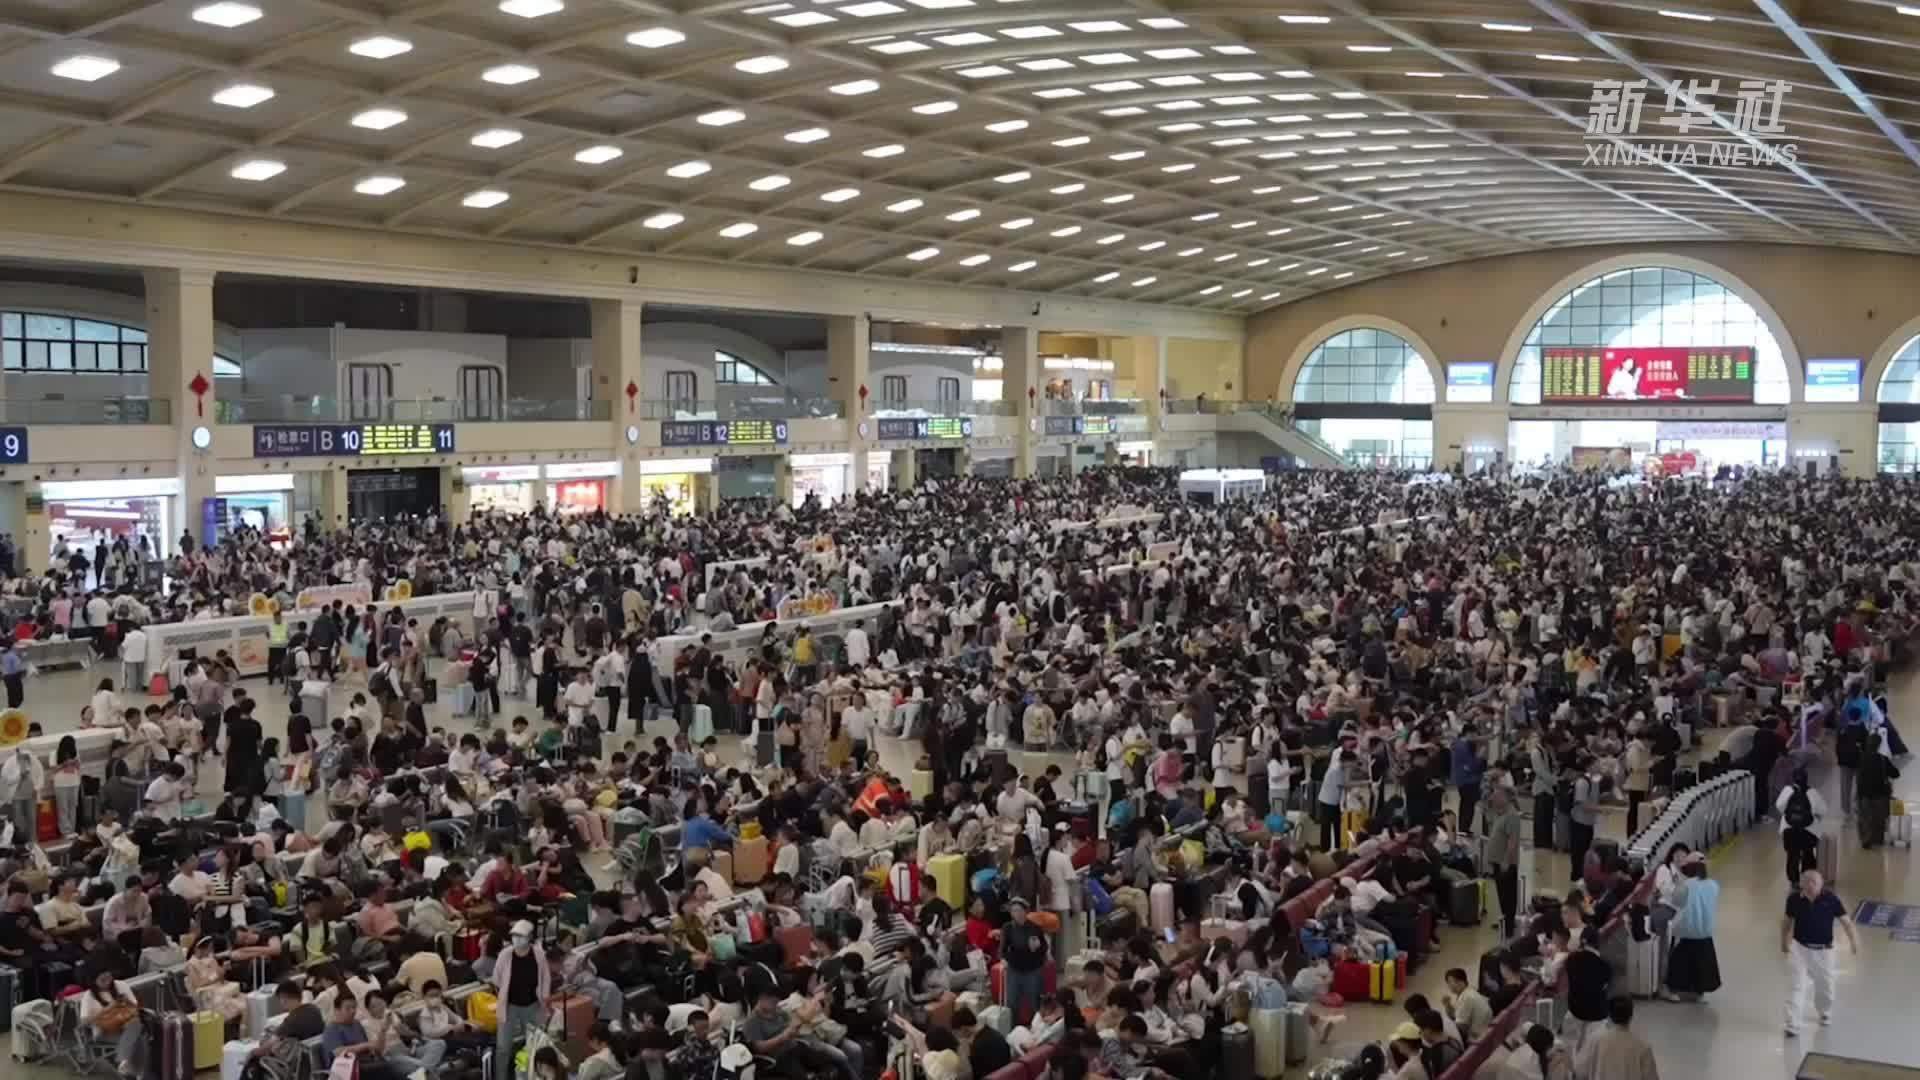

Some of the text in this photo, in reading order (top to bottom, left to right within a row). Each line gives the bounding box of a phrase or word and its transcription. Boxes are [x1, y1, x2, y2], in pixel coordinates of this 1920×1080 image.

[321, 430, 334, 450] B
[341, 430, 360, 450] 10
[438, 429, 452, 448] 11
[702, 425, 711, 441] B
[715, 425, 728, 441] 12
[4, 434, 20, 457] 9
